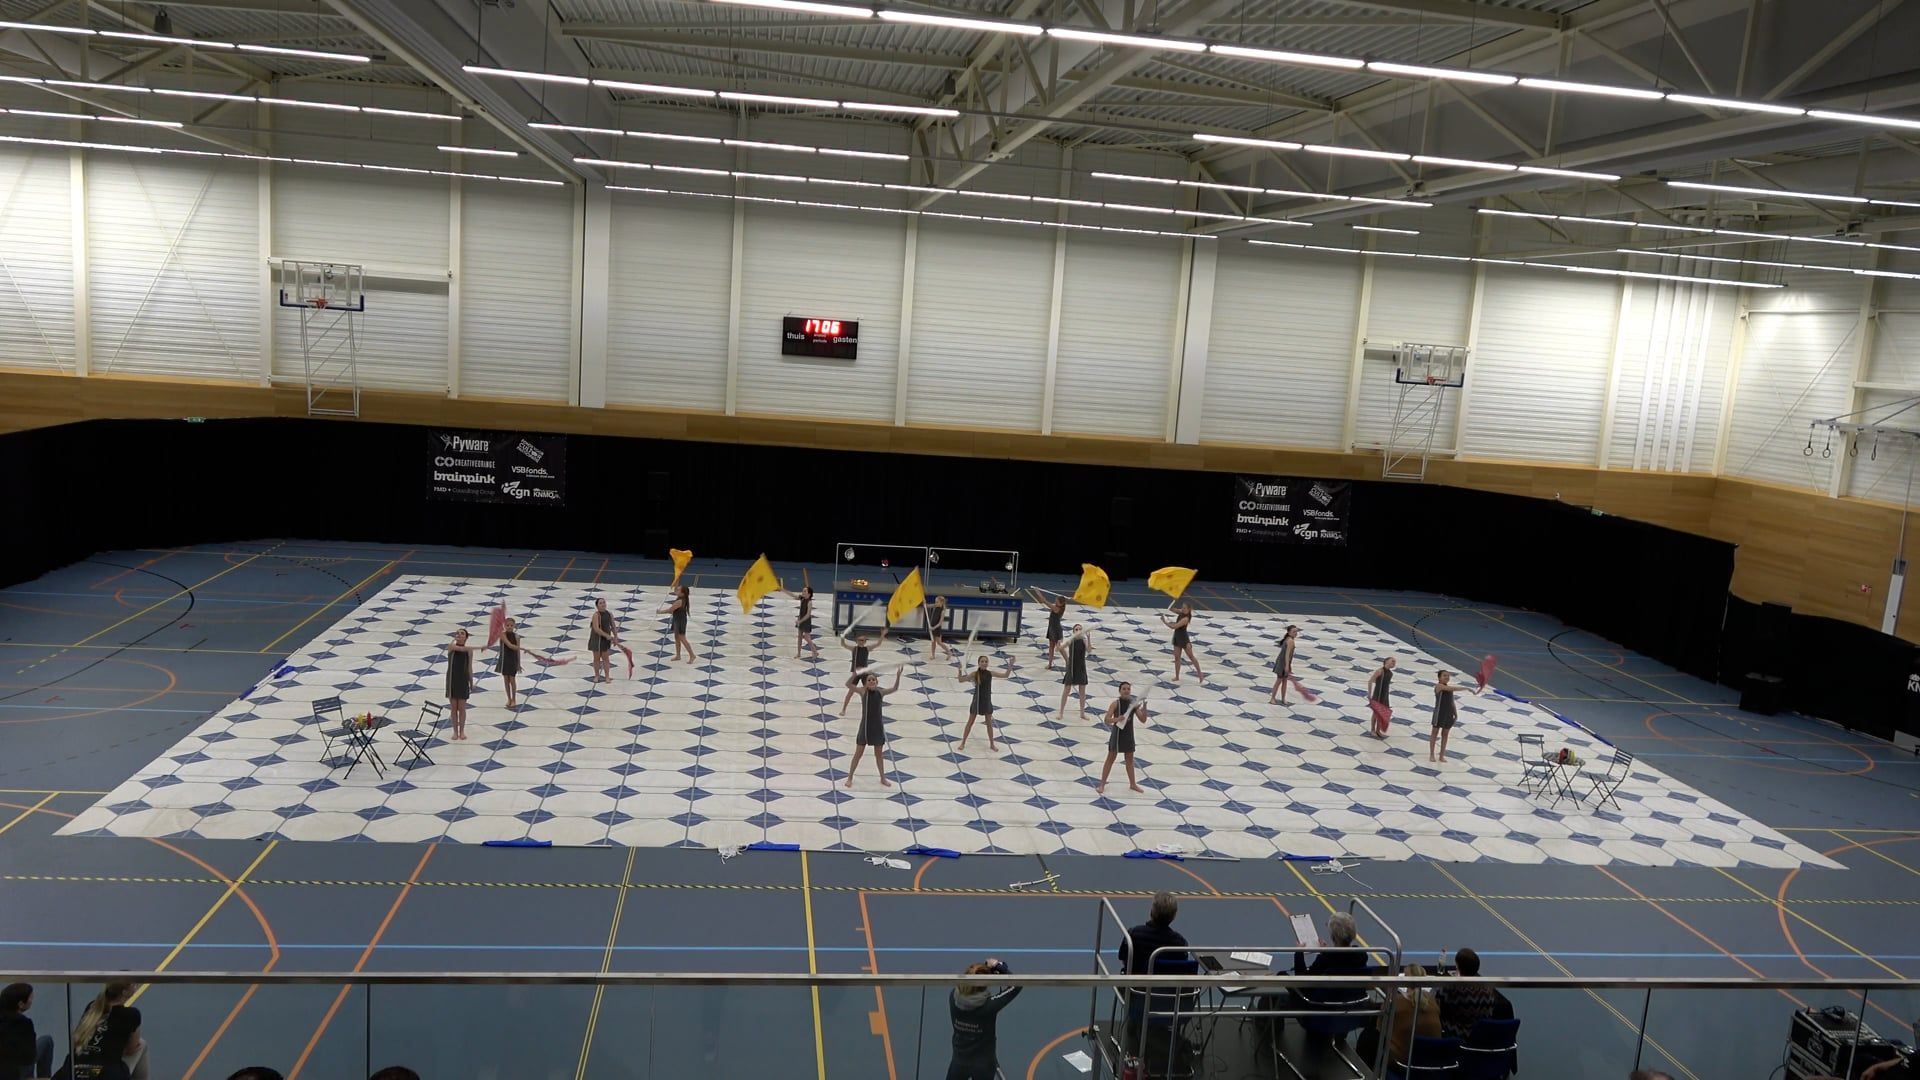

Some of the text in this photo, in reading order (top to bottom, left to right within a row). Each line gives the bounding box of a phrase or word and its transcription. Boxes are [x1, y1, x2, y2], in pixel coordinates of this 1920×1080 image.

[786, 332, 805, 340] thuis
[832, 336, 858, 344] gasten
[452, 435, 489, 452] Pyware
[433, 470, 496, 485] brainpink
[510, 488, 530, 499] cgn
[1255, 482, 1287, 498] Pyware
[1236, 513, 1289, 527] brainpink
[1300, 530, 1318, 540] cgn
